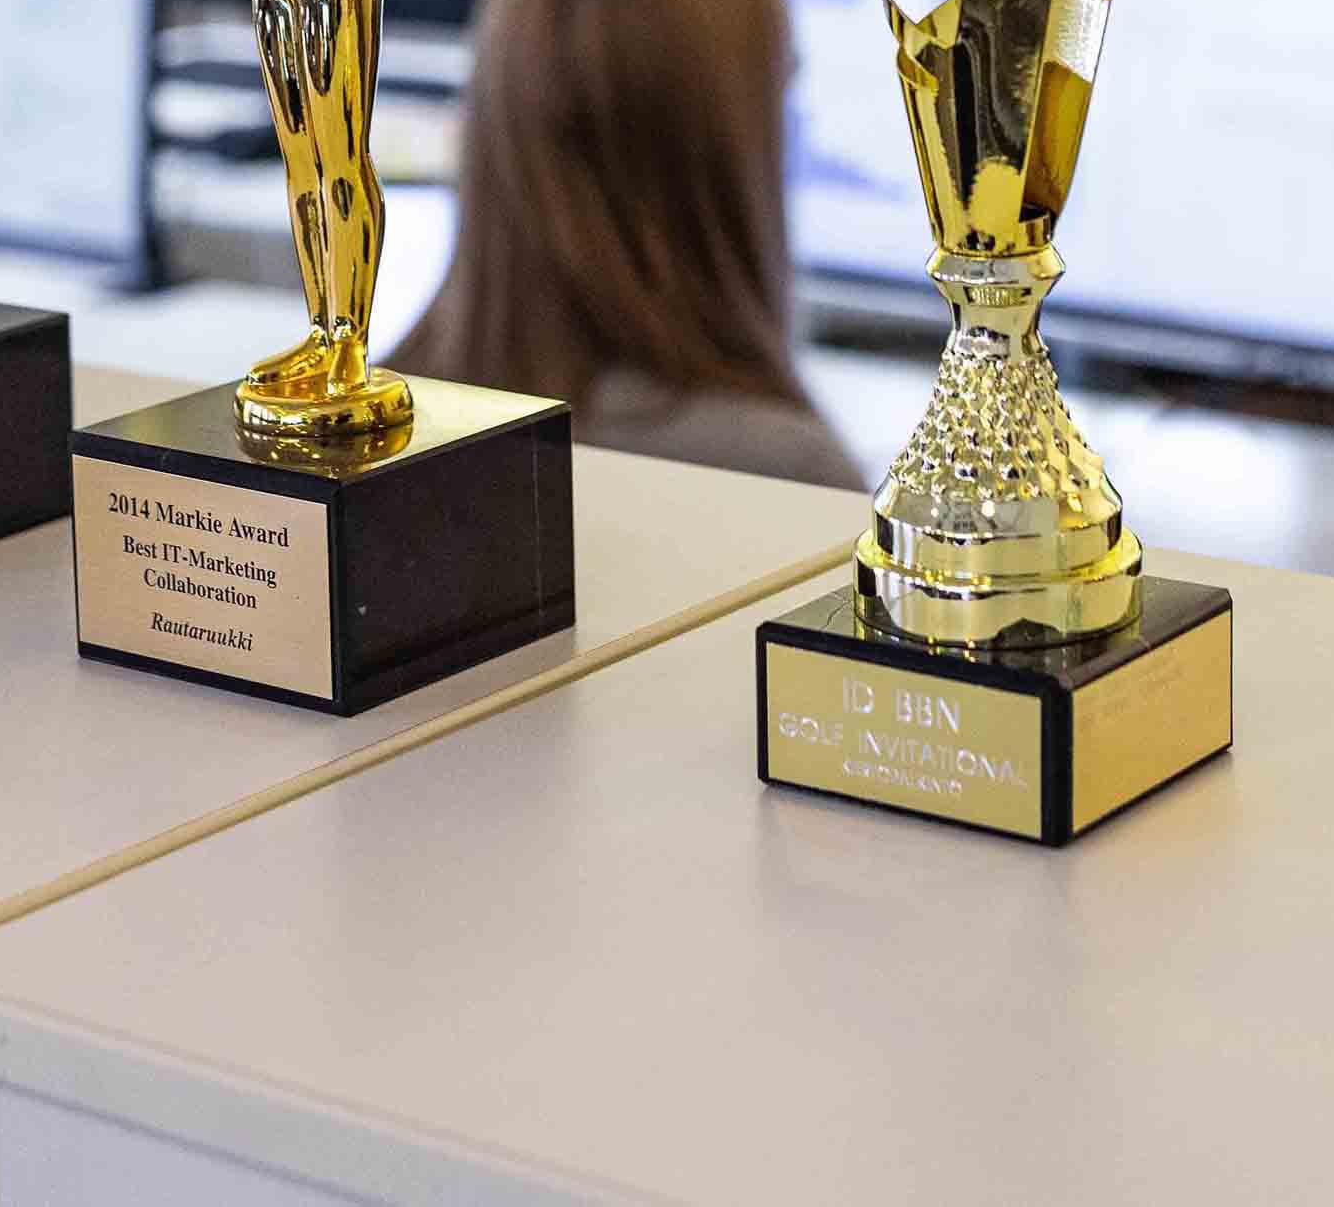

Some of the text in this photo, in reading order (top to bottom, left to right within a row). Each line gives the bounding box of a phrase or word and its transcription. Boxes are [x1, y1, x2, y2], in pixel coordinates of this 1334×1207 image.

[109, 492, 289, 547] 2014 Markie Award
[123, 535, 277, 588] Best IT-Marketing
[144, 568, 257, 609] Collaboration
[151, 612, 254, 651] Rautaruukki
[843, 675, 961, 734] ID BBN
[778, 712, 844, 747] GOLF
[859, 729, 1029, 793] INVITATIONAL
